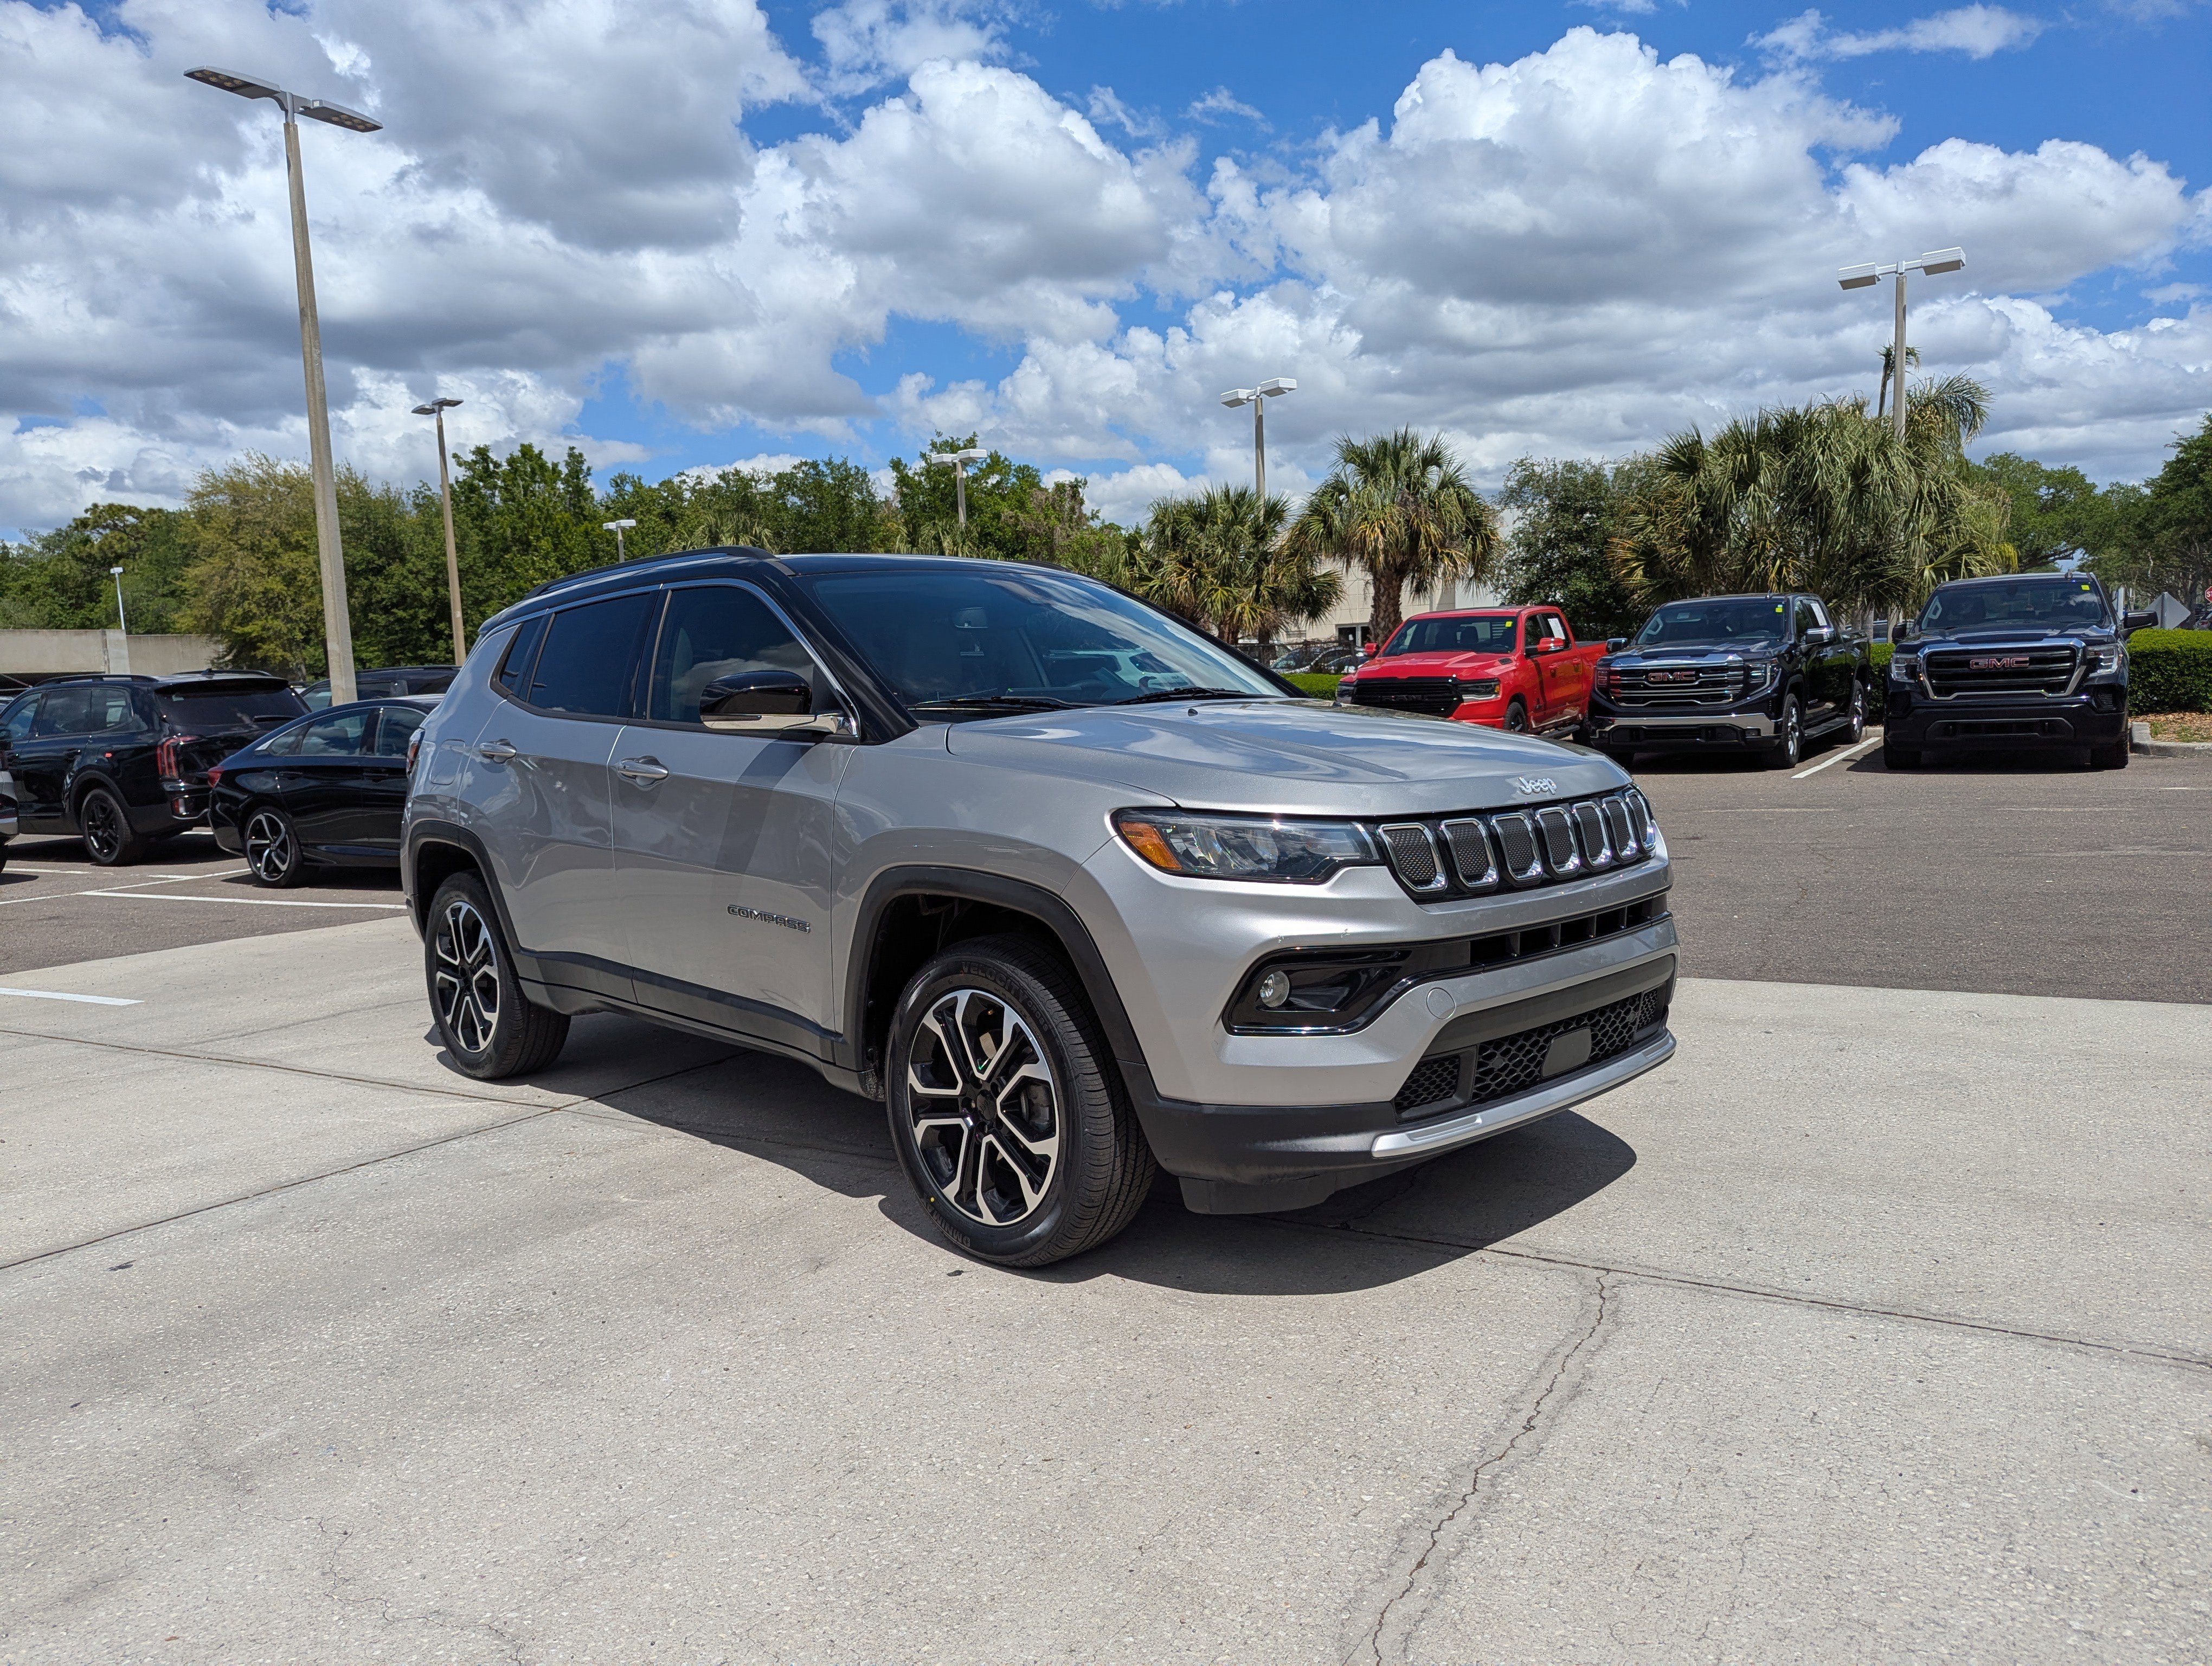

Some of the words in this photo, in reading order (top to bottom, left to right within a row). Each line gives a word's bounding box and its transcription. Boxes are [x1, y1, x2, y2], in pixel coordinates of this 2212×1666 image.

[1970, 657, 2029, 669] GMC
[1648, 671, 1696, 682] GMC
[1517, 777, 1557, 795] Jeep
[727, 905, 811, 934] COMPASS
[962, 962, 1029, 1003] VELOCITY
[1027, 1000, 1049, 1031] CROSS
